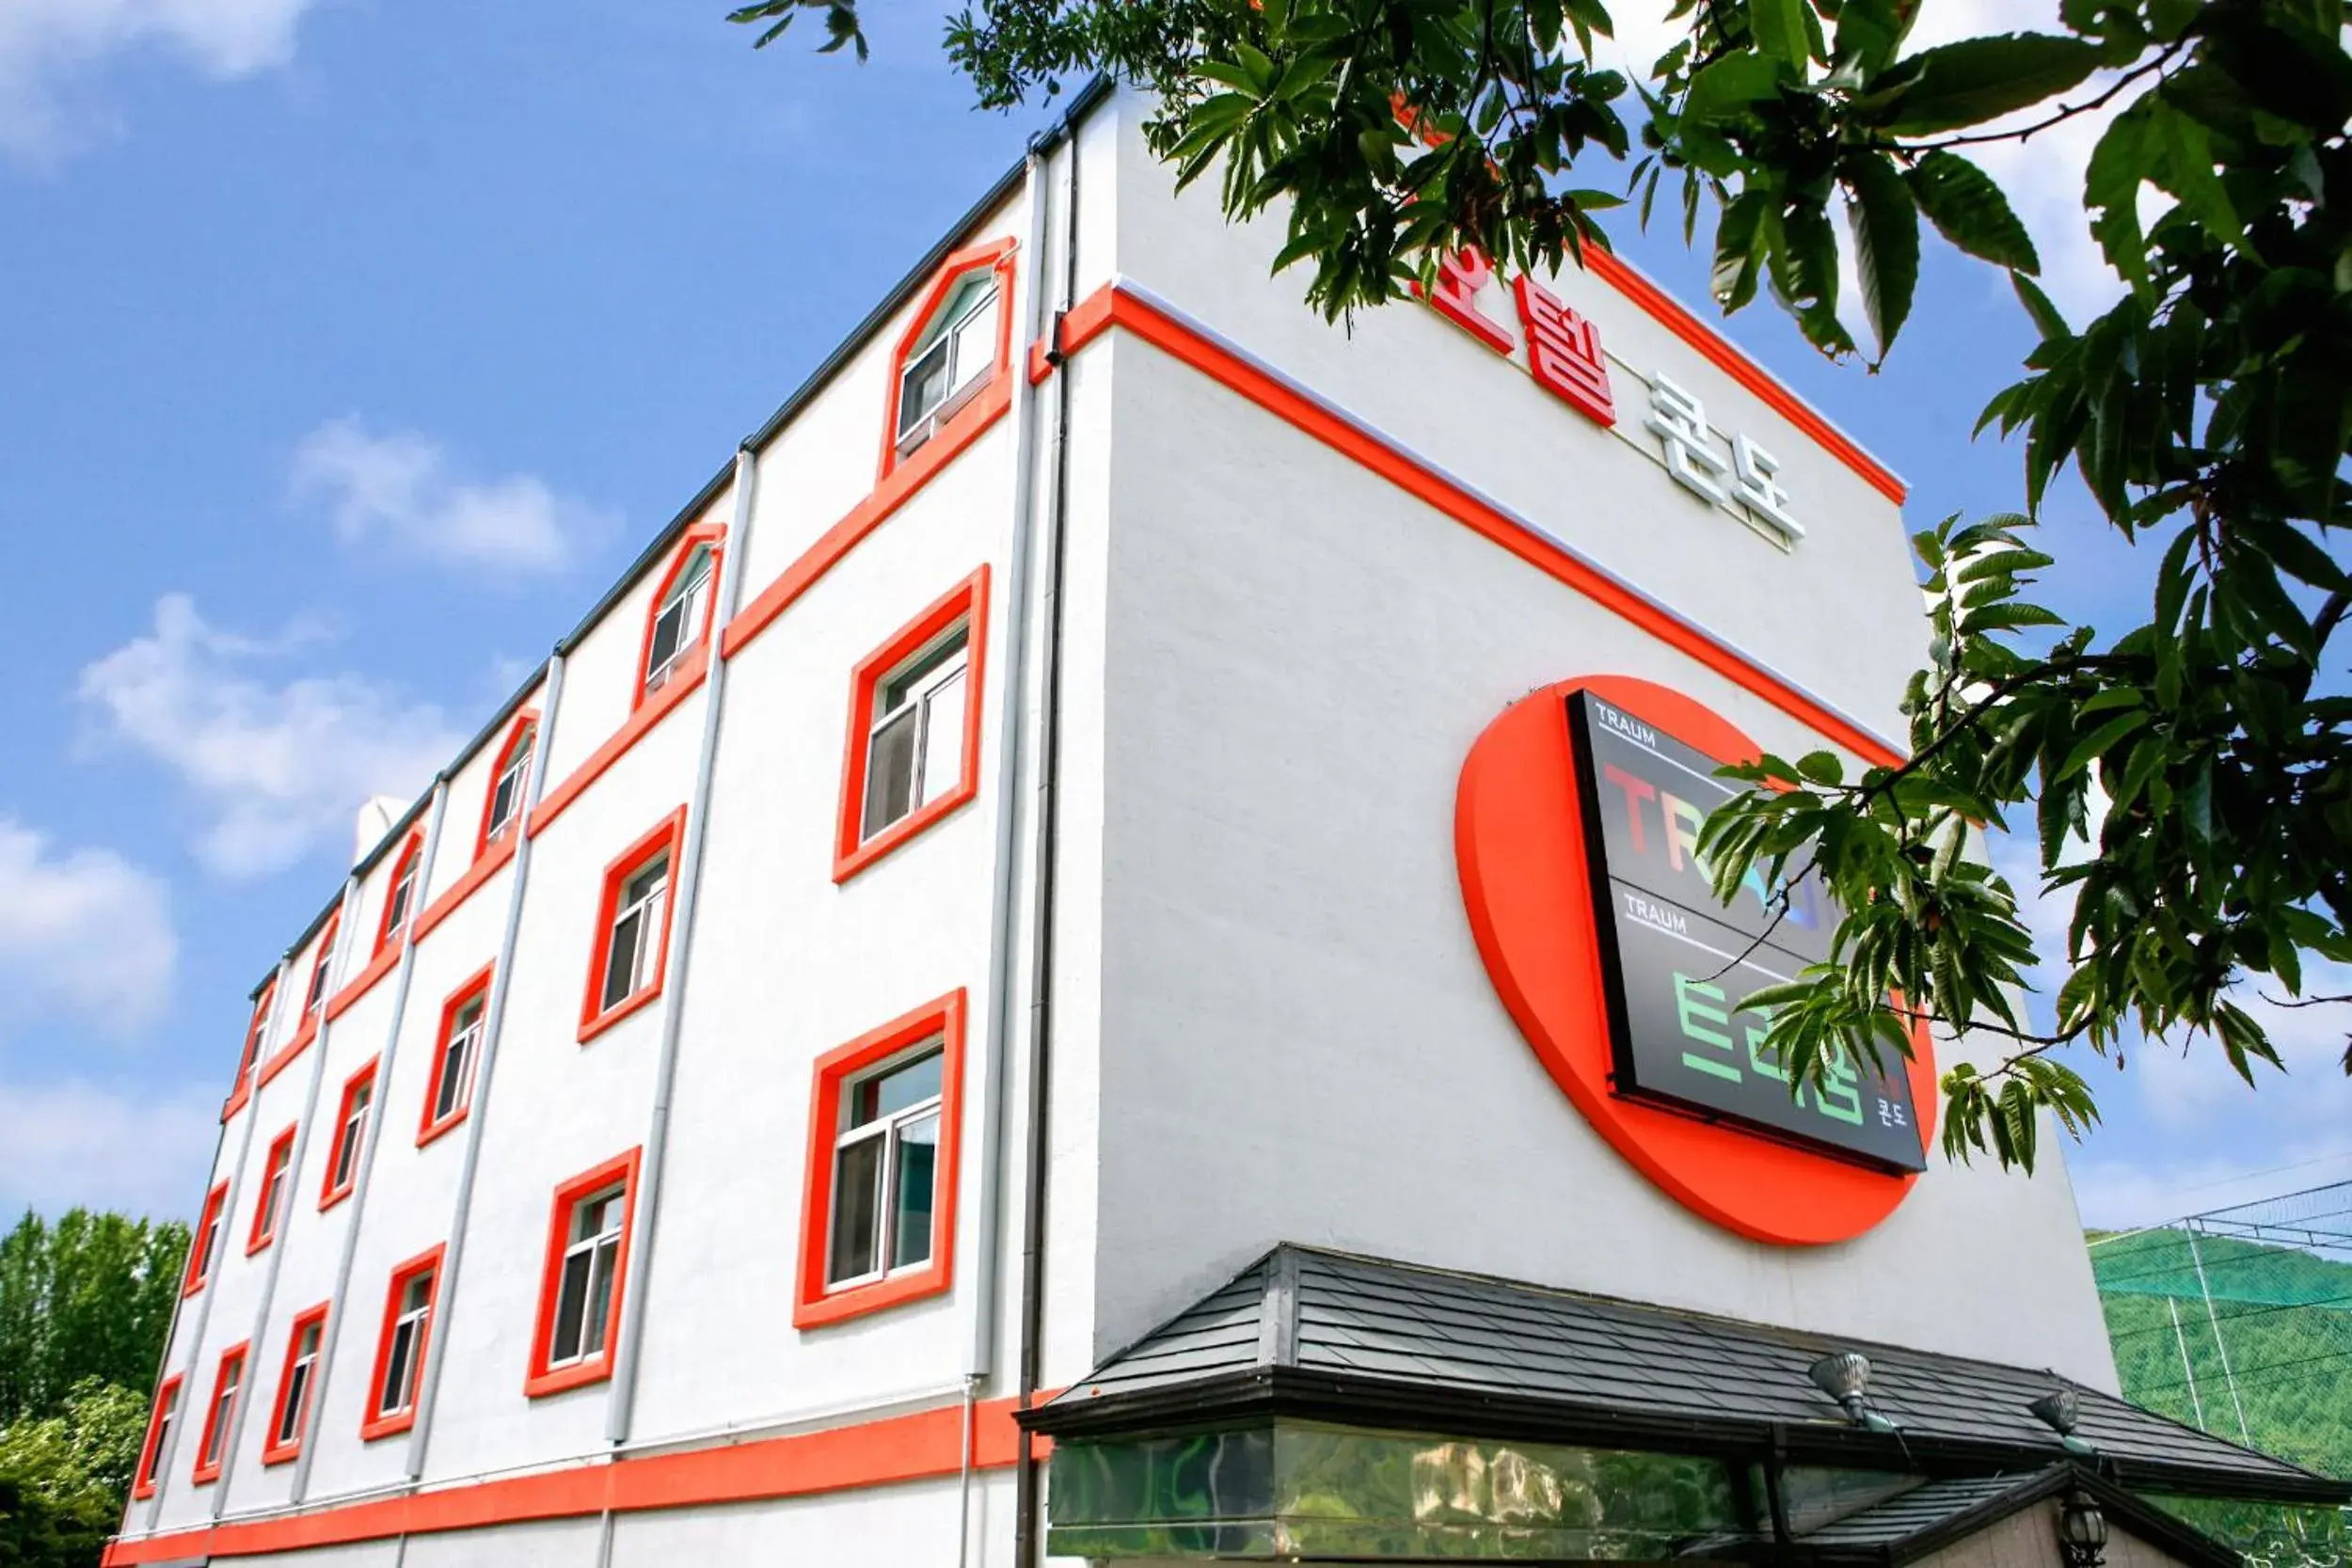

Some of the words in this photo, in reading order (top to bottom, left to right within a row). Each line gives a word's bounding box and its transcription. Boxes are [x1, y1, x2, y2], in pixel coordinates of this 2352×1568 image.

[1643, 369, 1806, 539] 콘도
[1596, 701, 1656, 748] TRAUM
[1624, 893, 1687, 934] TRAUM
[1877, 1098, 1907, 1127] 콘도
